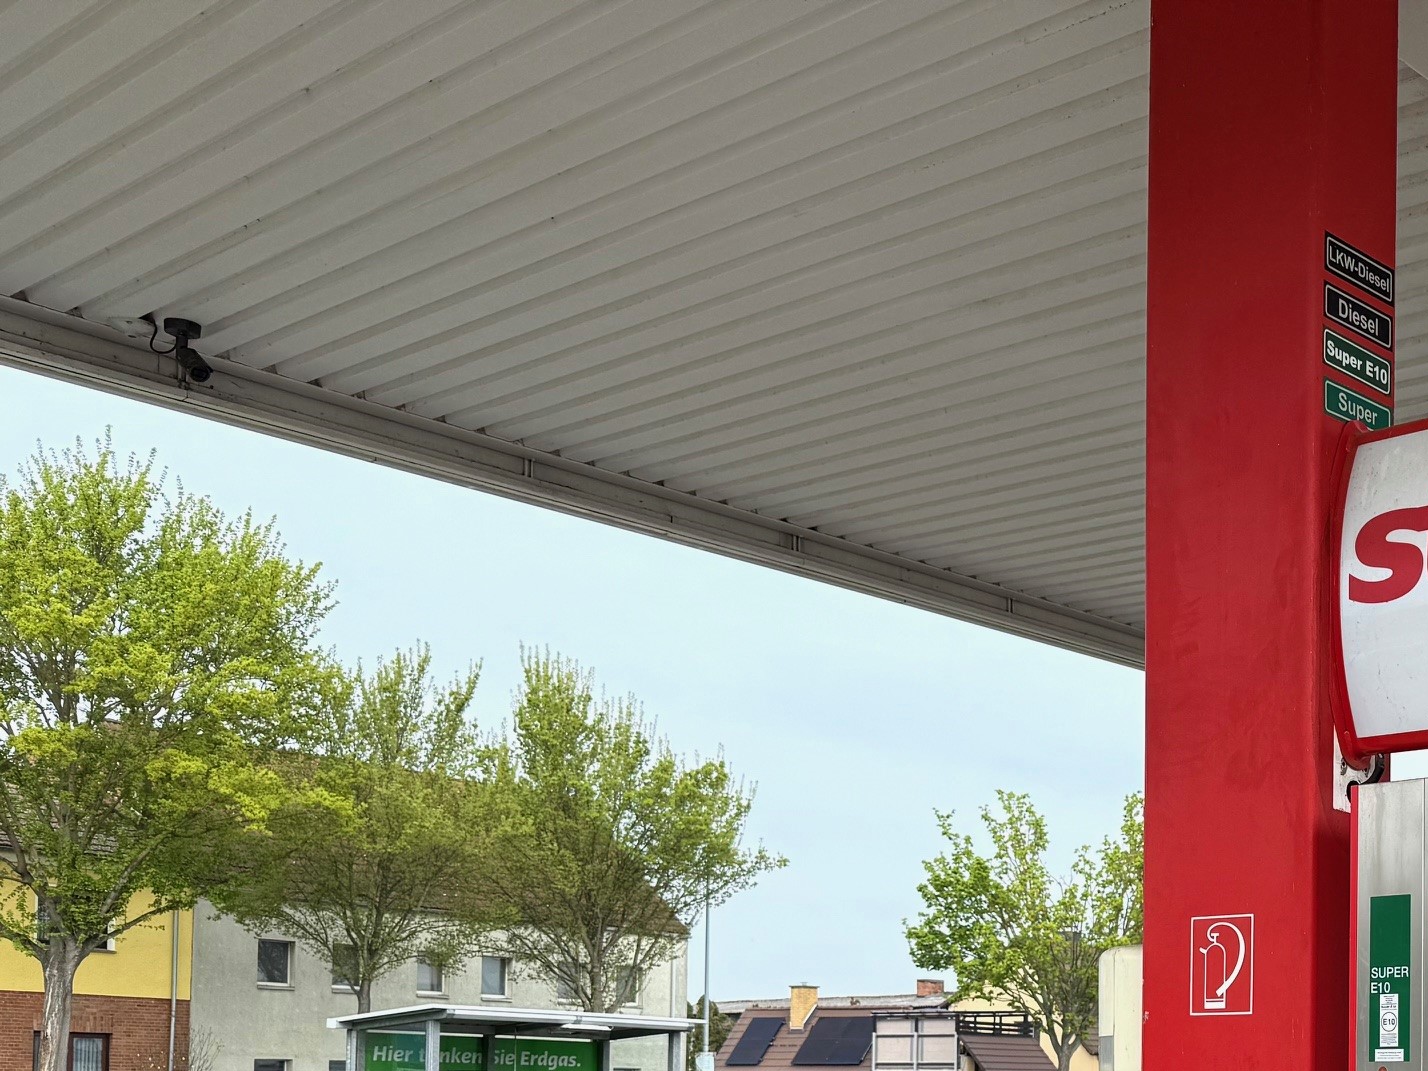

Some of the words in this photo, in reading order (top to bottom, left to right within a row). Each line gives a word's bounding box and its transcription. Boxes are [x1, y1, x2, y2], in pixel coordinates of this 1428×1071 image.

[1329, 245, 1390, 293] LKW-Diesel
[1338, 297, 1379, 336] Diesel
[1326, 339, 1363, 372] Super
[1365, 359, 1388, 385] E10
[1338, 392, 1378, 426] Super
[1370, 966, 1409, 979] SUPER
[1370, 982, 1391, 994] E10
[1382, 1018, 1396, 1026] E10
[373, 1045, 414, 1062] Hier
[419, 1048, 482, 1063] tnken
[520, 1050, 582, 1071] Erdgas.
